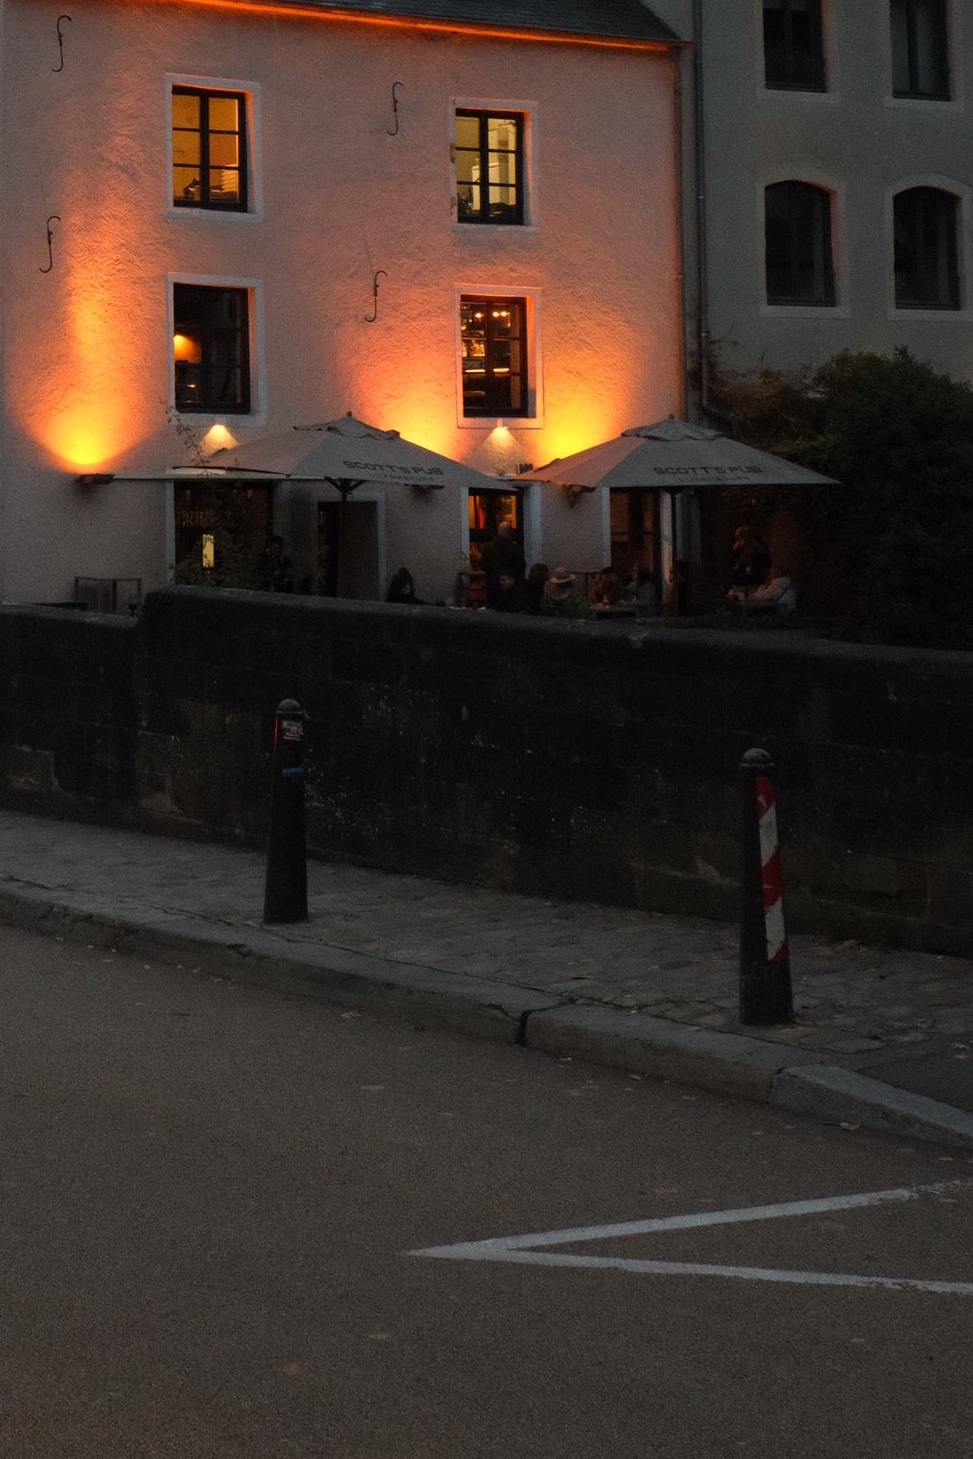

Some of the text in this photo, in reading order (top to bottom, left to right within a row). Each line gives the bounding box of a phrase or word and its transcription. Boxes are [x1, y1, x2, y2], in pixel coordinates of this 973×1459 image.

[342, 460, 444, 475] SCOTT'S PUB
[653, 466, 763, 475] SCOTT'S PUB
